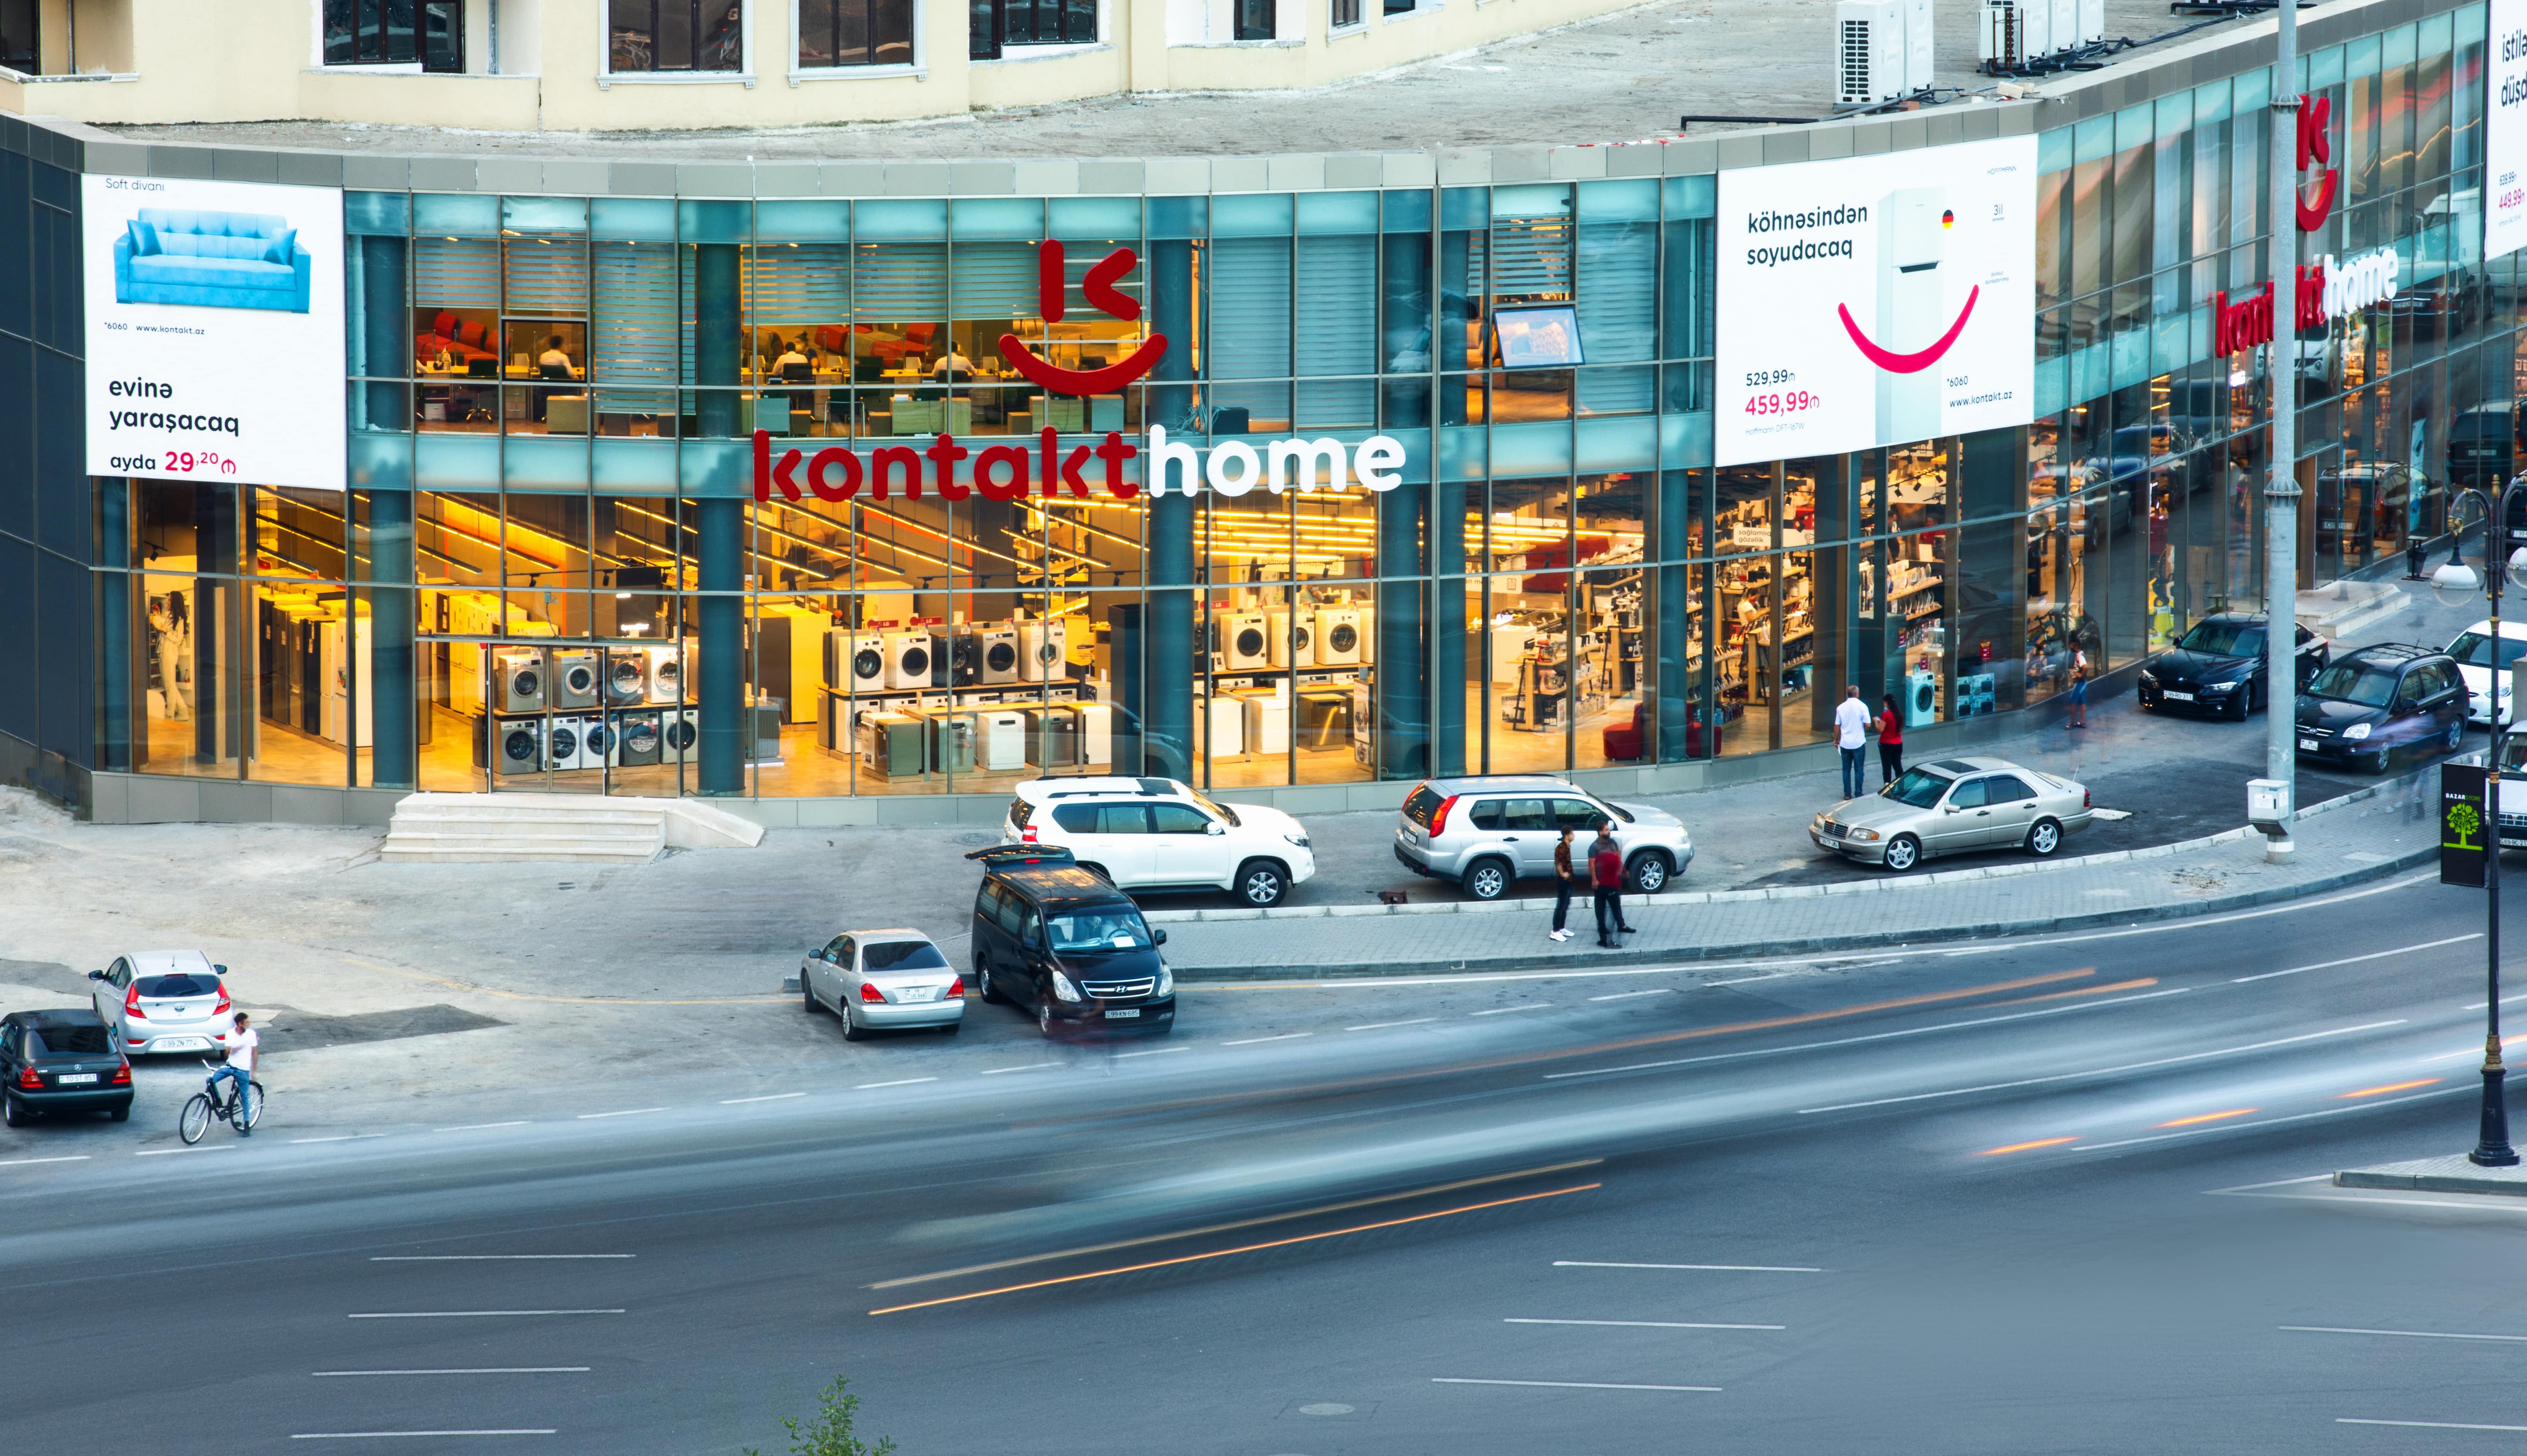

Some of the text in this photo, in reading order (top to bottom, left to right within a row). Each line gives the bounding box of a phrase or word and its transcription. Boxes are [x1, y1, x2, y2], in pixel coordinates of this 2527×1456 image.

[1987, 166, 2016, 175] HOFFMANN
[106, 178, 165, 191] Soft divanı
[1748, 203, 1867, 234] köhnəsindən
[1747, 239, 1852, 267] soyudacaq
[136, 325, 205, 335] www.kontakt.az
[109, 377, 173, 399] evinə
[1949, 391, 2012, 408] www.kontakt.az
[109, 411, 239, 437] yaraşacaq
[1745, 426, 1774, 435] Hoffmann
[110, 454, 156, 472] ayda
[752, 424, 1406, 502] kontakthome
